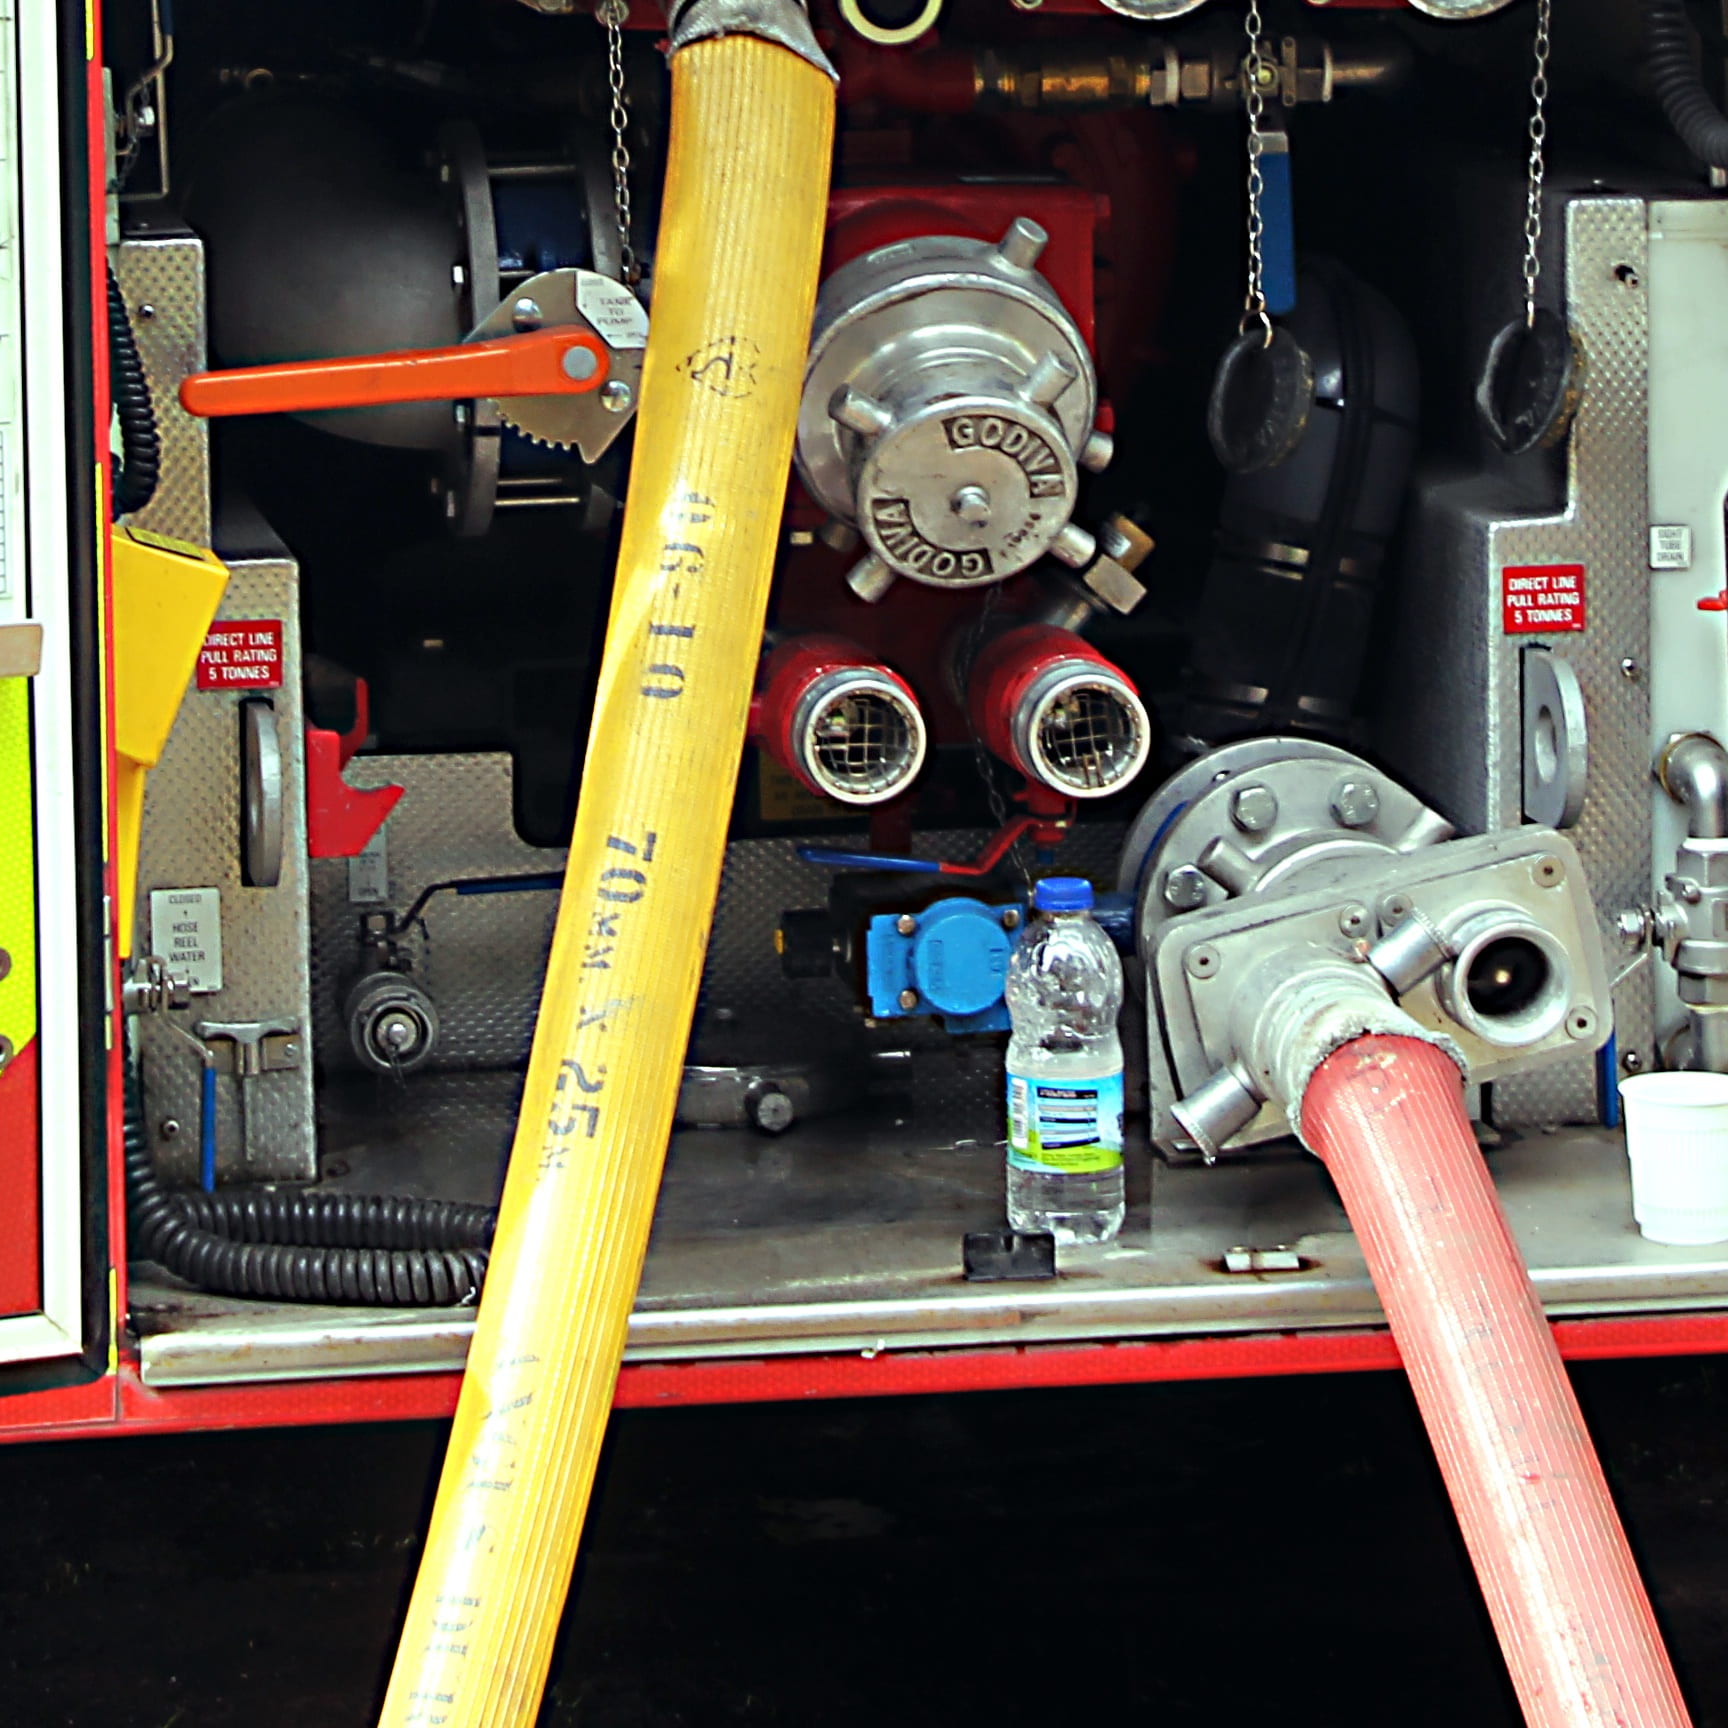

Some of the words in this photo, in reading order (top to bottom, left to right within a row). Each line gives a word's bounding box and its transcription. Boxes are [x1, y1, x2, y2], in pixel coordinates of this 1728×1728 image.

[952, 416, 1066, 497] GODIVA
[874, 500, 985, 577] GODIVA
[1509, 576, 1549, 590] DIRECT
[1553, 576, 1576, 589] LINE
[1507, 594, 1534, 607] PULL
[1538, 592, 1580, 605] RATING
[1514, 611, 1522, 624] 5
[1527, 609, 1572, 622] TONNES
[204, 633, 244, 646] DIRECT
[248, 632, 274, 645] LINE
[200, 650, 228, 664] PULL
[233, 648, 277, 662] RATING
[209, 667, 217, 680] 5
[221, 665, 270, 680] TONNES
[173, 922, 198, 932] HOSE
[174, 936, 198, 947] REEL
[169, 951, 205, 961] WATER
